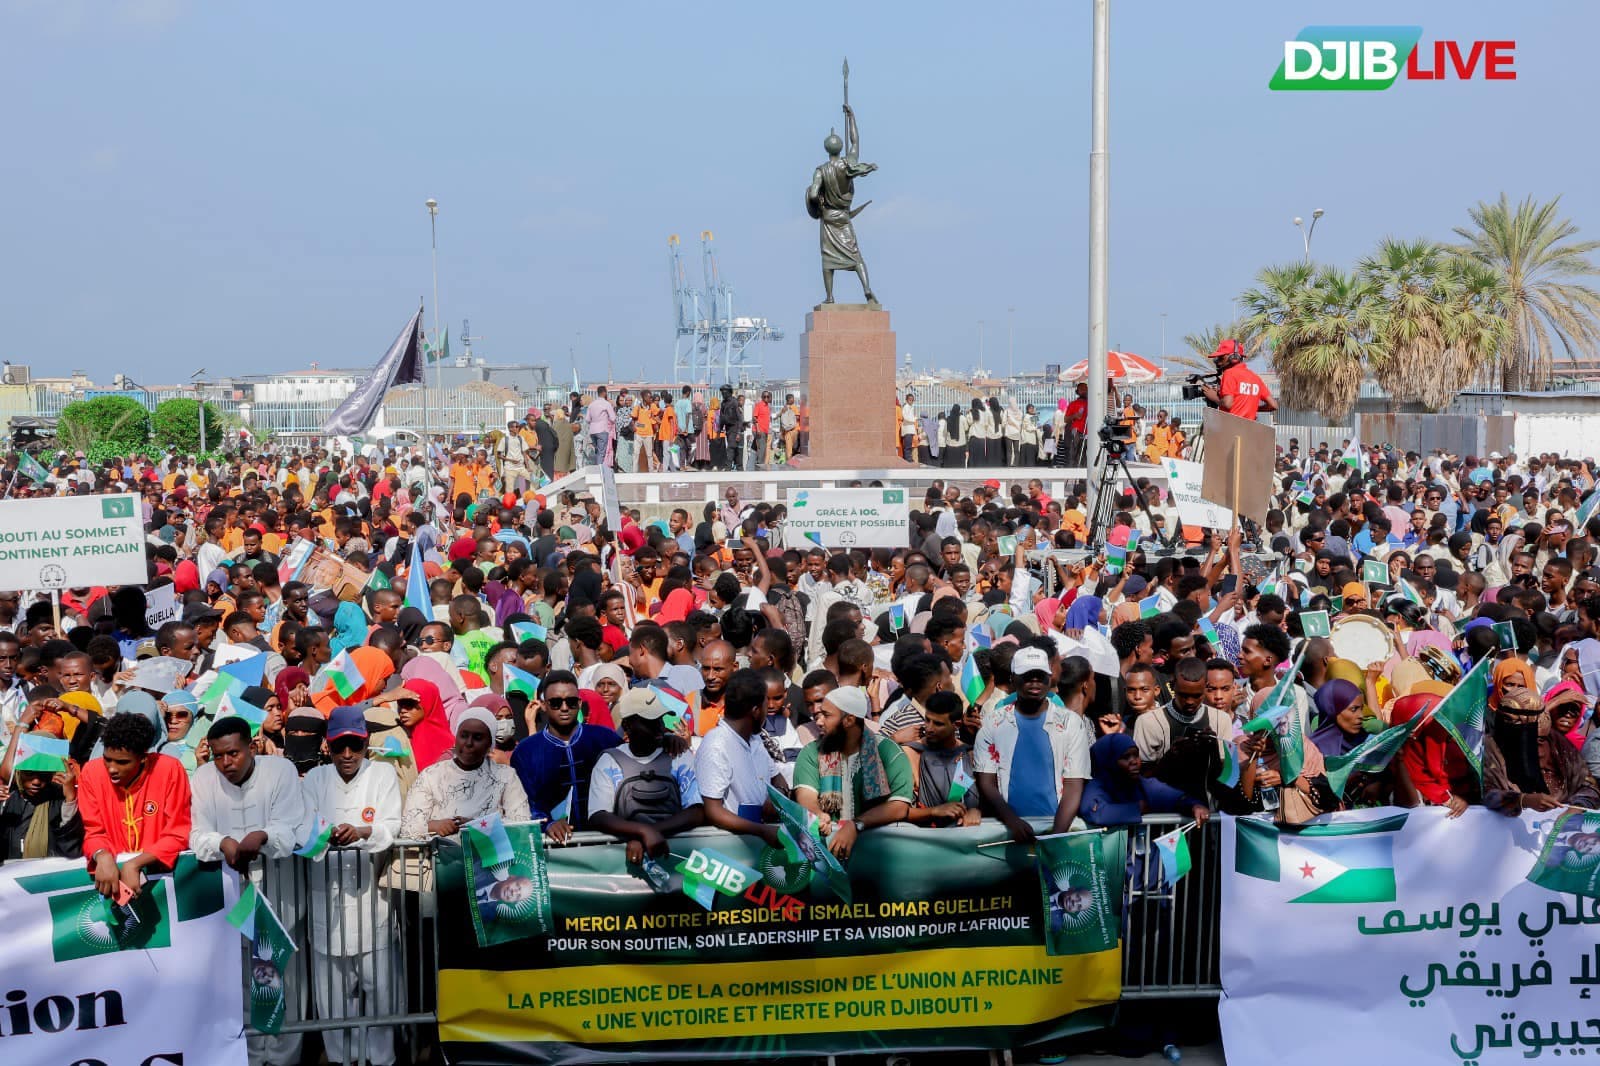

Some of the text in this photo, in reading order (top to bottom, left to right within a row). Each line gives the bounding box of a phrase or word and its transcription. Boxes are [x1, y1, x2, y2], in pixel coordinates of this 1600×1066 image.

[790, 519, 906, 528] TOUT DEVIENT POSSIBLE
[816, 507, 848, 517] GRÂCE
[851, 507, 858, 516] À
[42, 530, 62, 540] AU
[65, 526, 127, 540] SOMMET
[73, 543, 139, 557] AFRICAIN
[565, 915, 620, 932] MERCI
[624, 915, 638, 931] A
[643, 912, 702, 929] NOTRE
[810, 903, 875, 921] ISMAEL
[879, 901, 930, 918] OMAR
[933, 896, 1013, 914] GUELLEH
[547, 938, 588, 952] POUR
[590, 938, 621, 951] SON
[624, 936, 692, 951] SOUTIEN,
[695, 933, 726, 948] SON
[729, 929, 820, 946] LEADERSHIP
[823, 928, 842, 942] ET
[844, 927, 865, 941] SA
[867, 924, 916, 940] VISION
[918, 922, 956, 937] POUR
[508, 993, 535, 1009] LA
[539, 985, 662, 1009] PRESIDENCE
[667, 984, 692, 1000] DE
[697, 983, 724, 998] LA
[727, 977, 848, 998] COMMISSION
[852, 974, 877, 992] DE
[961, 967, 1064, 988] AFRICAINE
[0, 989, 127, 1038] ion
[596, 1012, 637, 1031] UNE
[641, 1006, 729, 1028] VICTOIRE
[733, 1004, 758, 1023] ET
[762, 1002, 830, 1022] FIERTE
[834, 1000, 885, 1018] POUR
[891, 996, 978, 1016] DJIBOUTI
